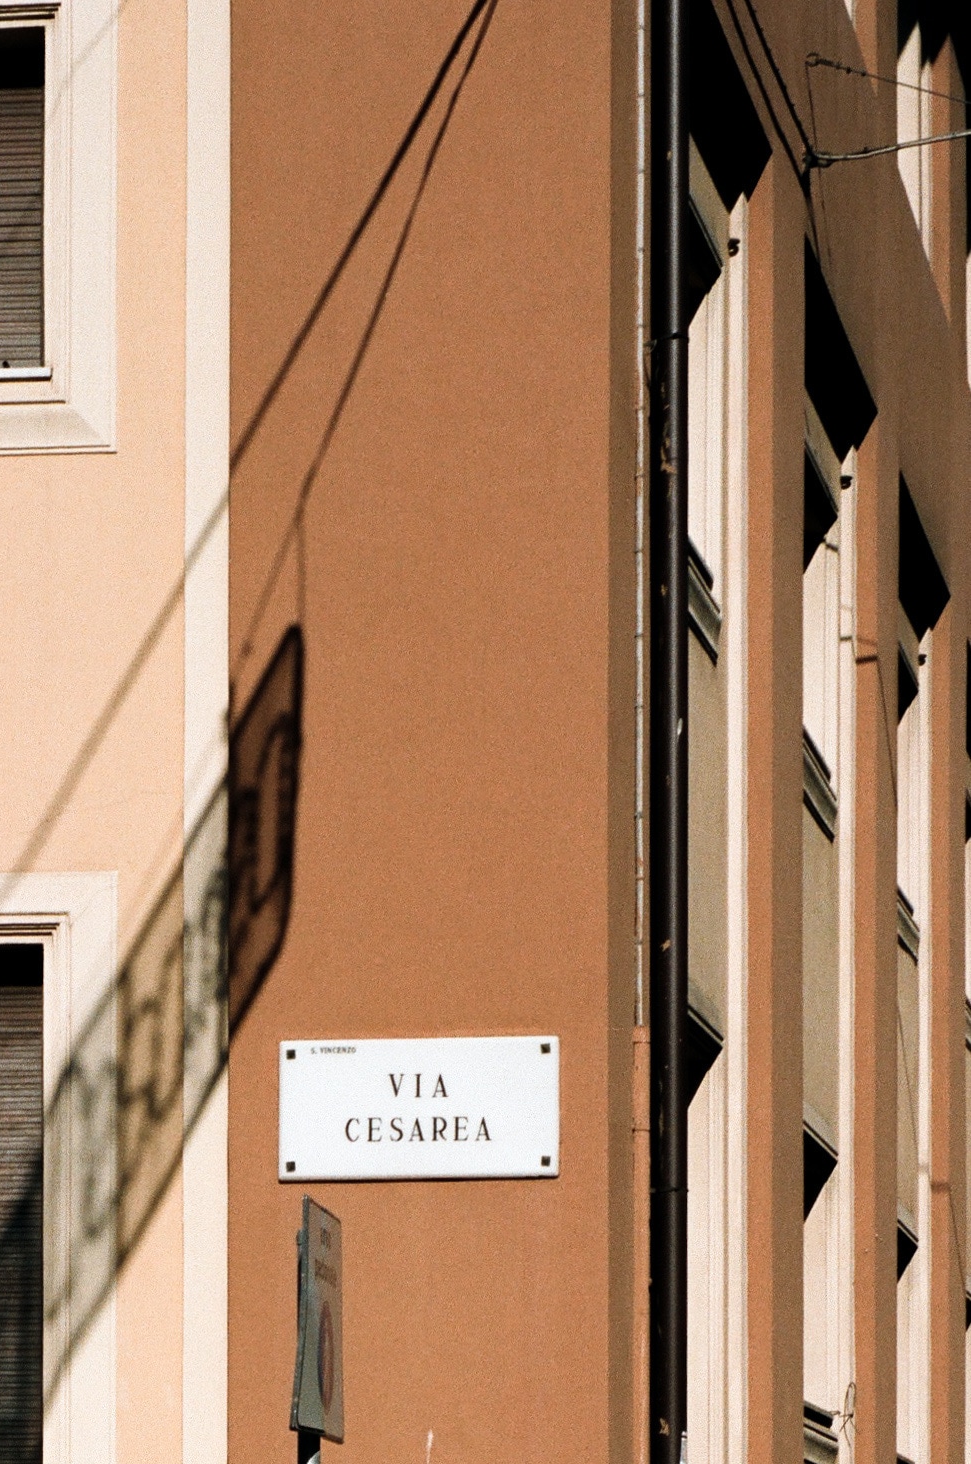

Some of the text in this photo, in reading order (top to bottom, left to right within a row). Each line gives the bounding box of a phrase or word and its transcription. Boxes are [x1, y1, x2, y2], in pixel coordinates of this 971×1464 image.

[320, 1046, 357, 1054] VINCENZO
[388, 1073, 449, 1098] VIA
[345, 1116, 492, 1142] CESAREA
